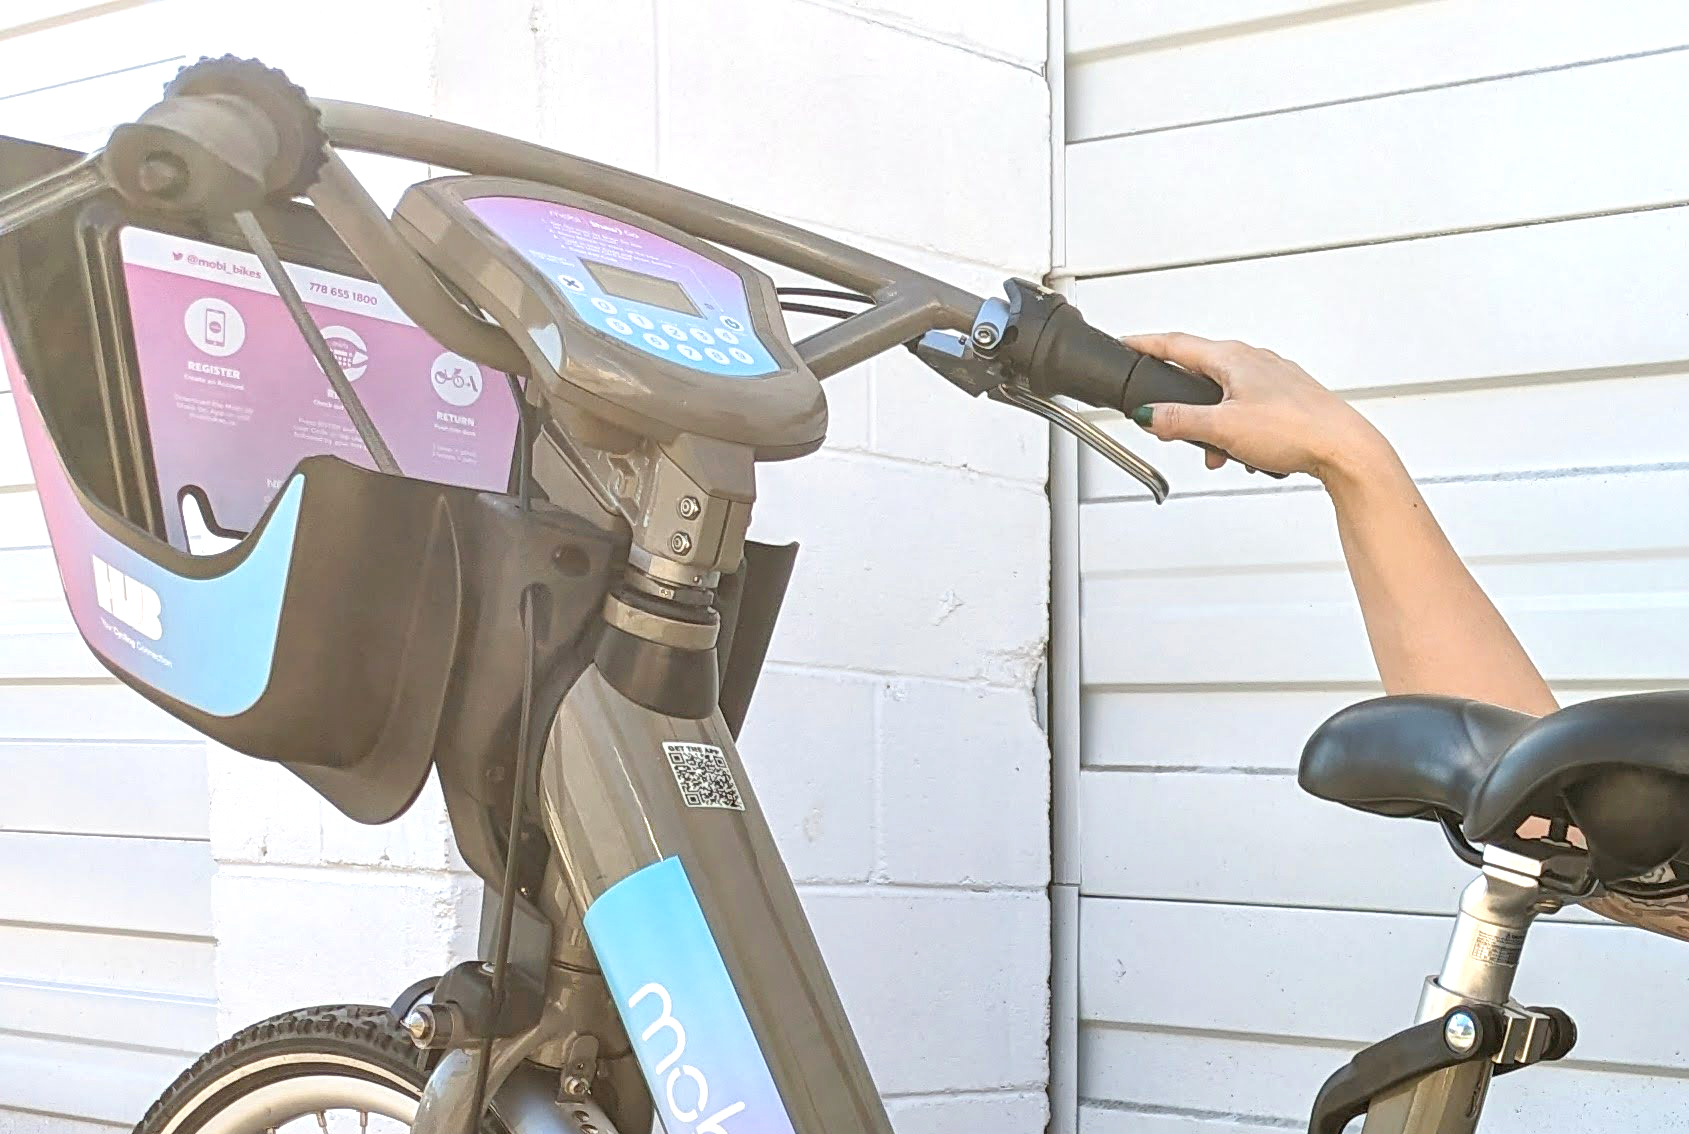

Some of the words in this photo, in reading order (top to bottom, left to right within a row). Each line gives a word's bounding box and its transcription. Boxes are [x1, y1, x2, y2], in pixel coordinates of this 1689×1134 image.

[187, 254, 262, 280] @mobi_bikes
[309, 282, 327, 294] 778
[330, 286, 349, 300] 655
[352, 291, 378, 306] 1800
[187, 361, 241, 380] REGISTER
[436, 410, 476, 428] RETURN
[92, 554, 163, 641] HUB
